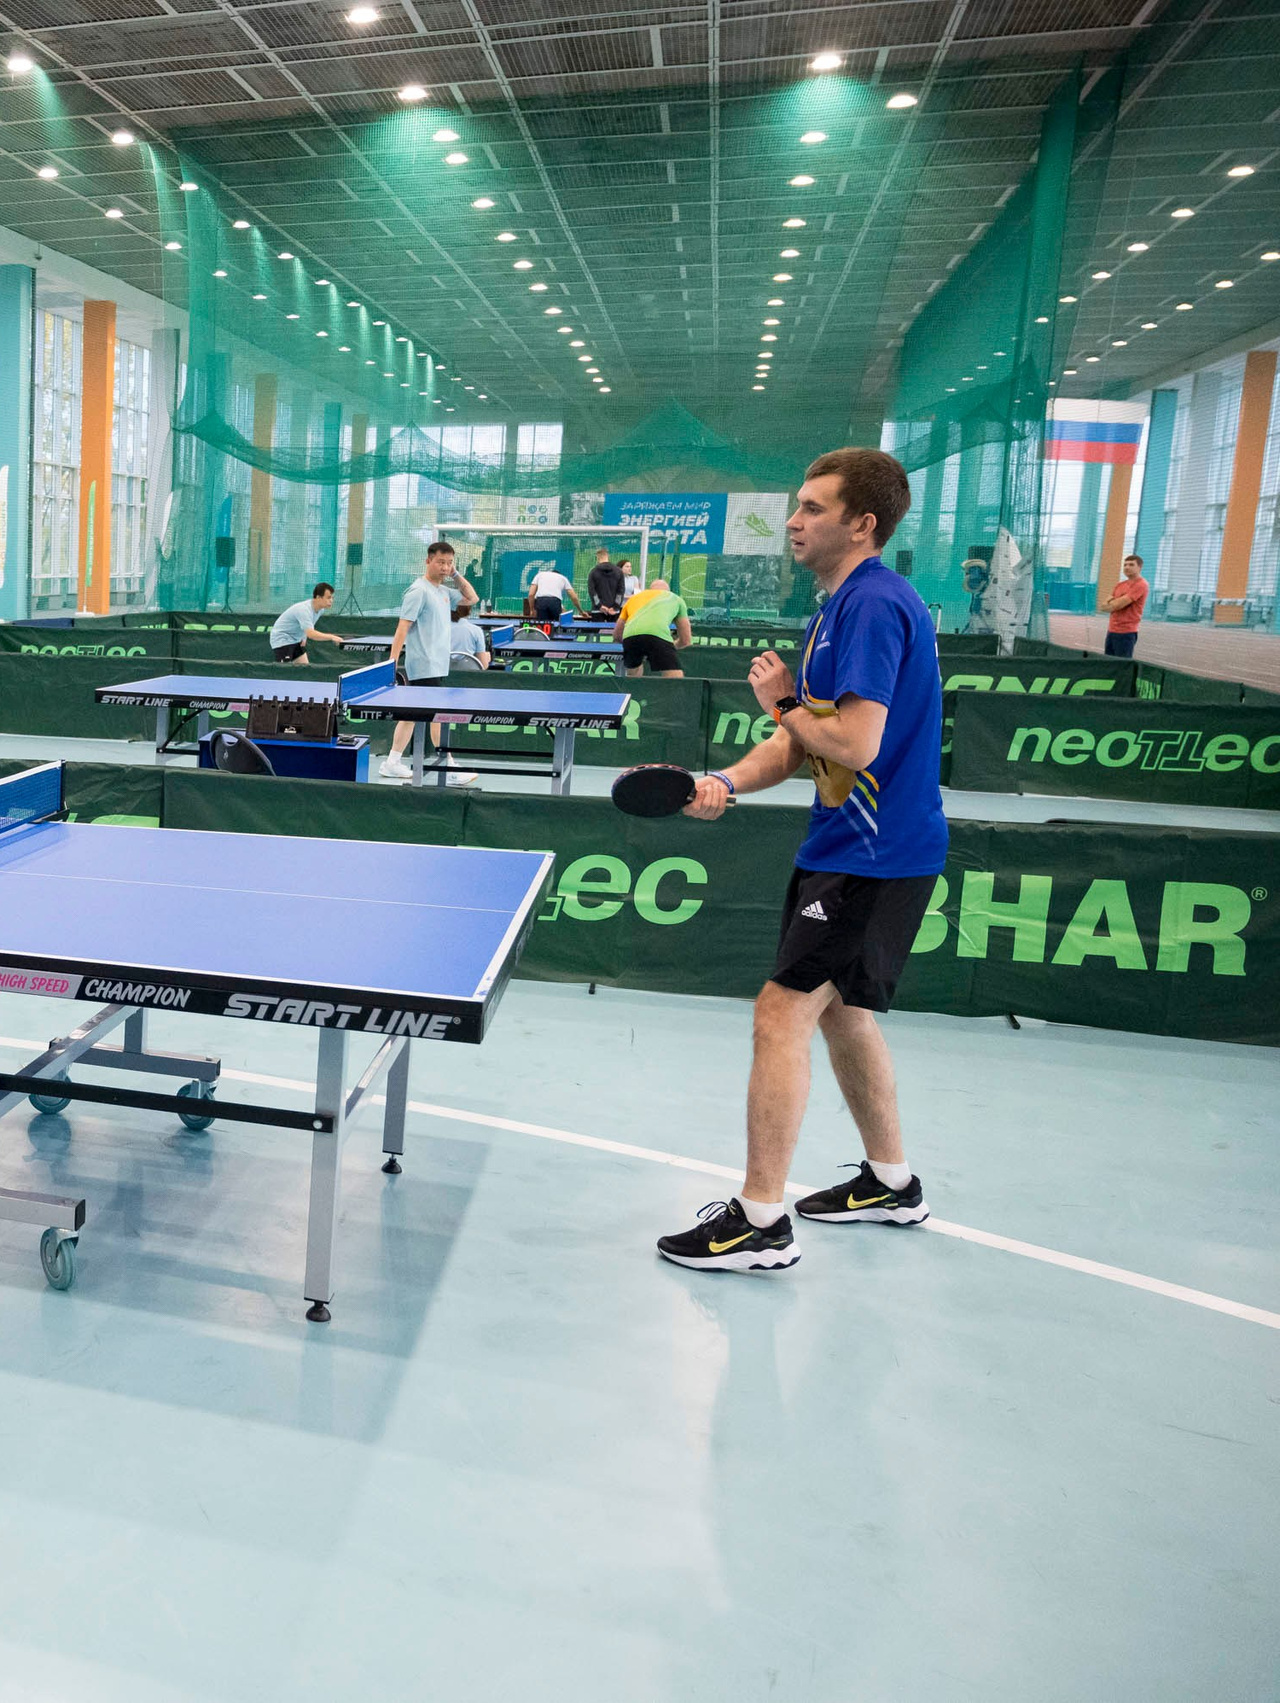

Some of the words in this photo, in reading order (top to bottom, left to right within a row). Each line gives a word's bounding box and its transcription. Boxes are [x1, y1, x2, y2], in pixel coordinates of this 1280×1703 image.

[618, 511, 710, 527] ЭНЕРГИЕЙ
[620, 529, 708, 545] ОРТА
[100, 694, 144, 706] START
[144, 697, 172, 707] LINE
[189, 700, 227, 710] CHAMPION
[360, 710, 382, 720] ITTF
[472, 715, 516, 725] CHAMPION
[528, 716, 580, 728] START
[580, 718, 612, 729] LINE
[801, 909, 828, 921] adidas
[29, 976, 70, 994] SPEED
[84, 978, 191, 1008] CHAMPION
[222, 992, 362, 1028] START
[366, 1008, 454, 1039] LINE
